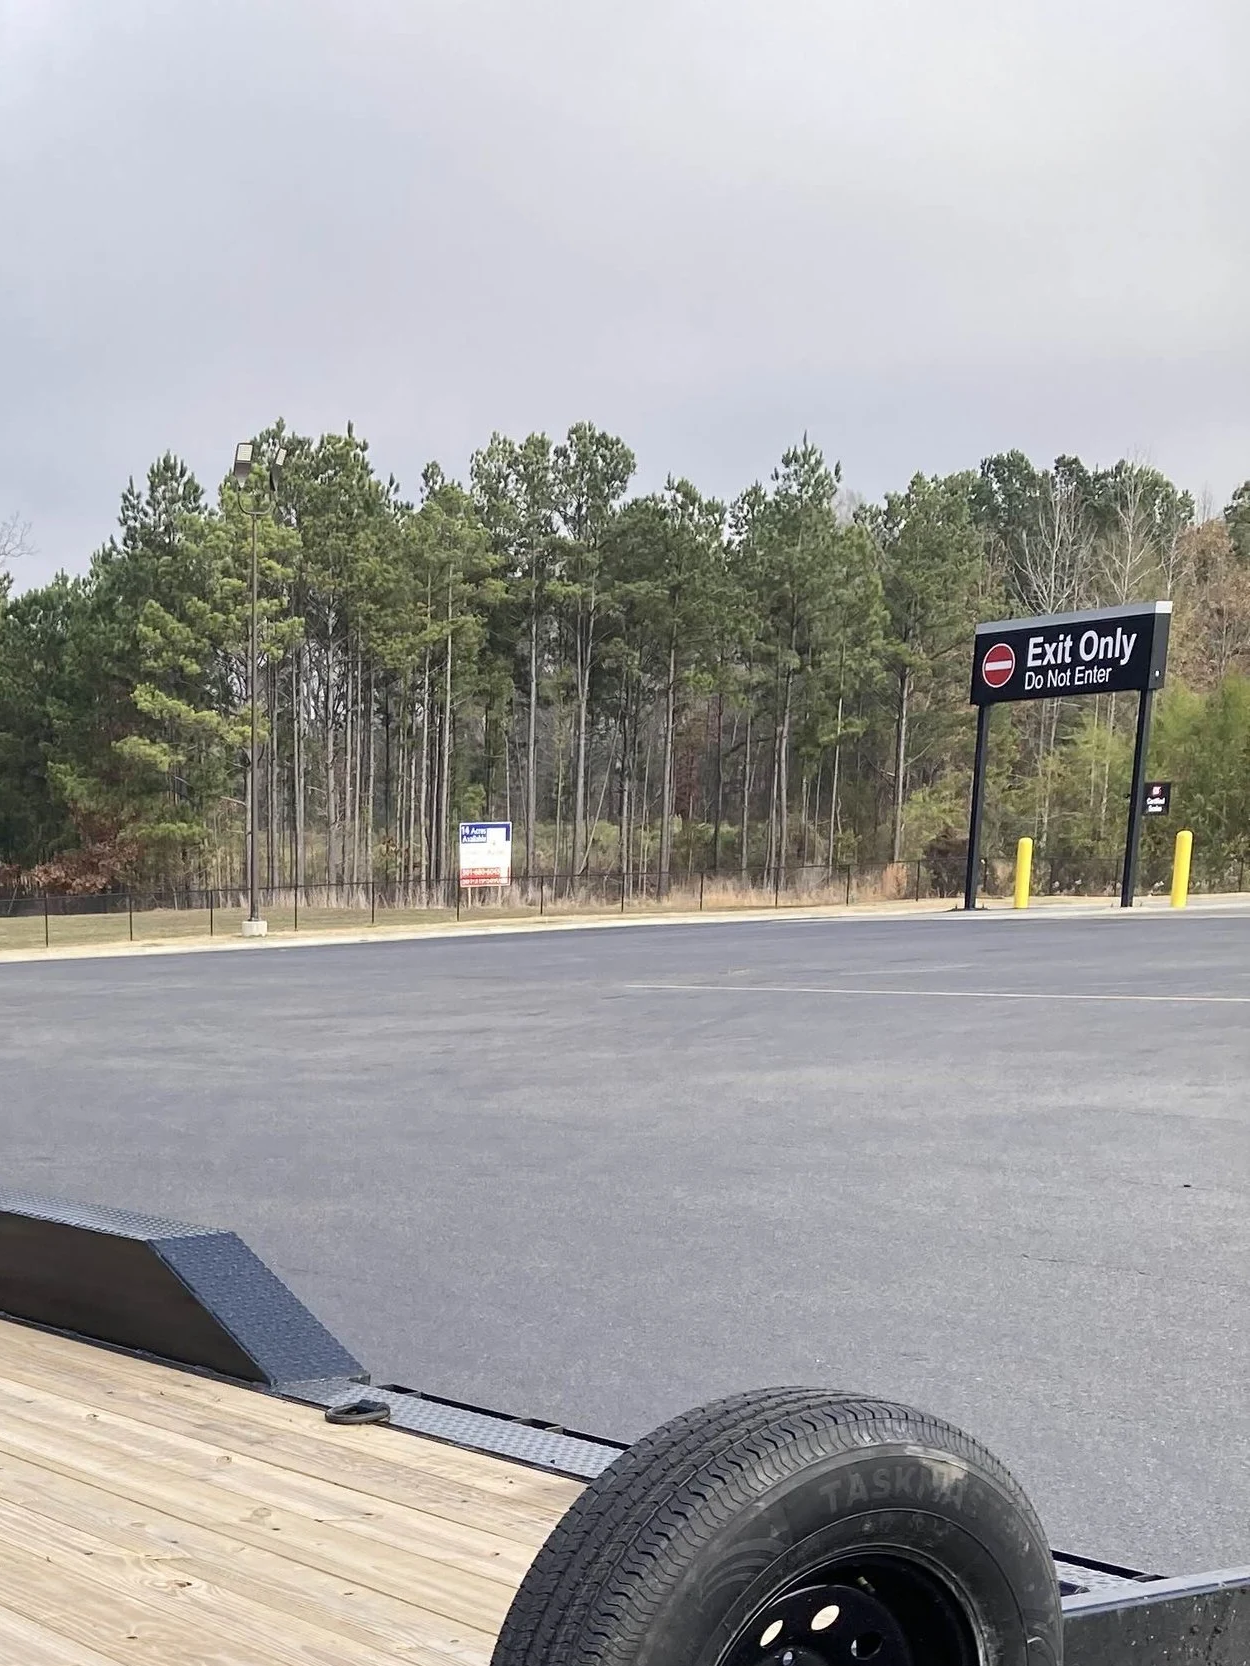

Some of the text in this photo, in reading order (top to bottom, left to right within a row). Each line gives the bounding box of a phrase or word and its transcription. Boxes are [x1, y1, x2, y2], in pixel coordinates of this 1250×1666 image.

[1026, 627, 1137, 667] Exit Only
[1024, 665, 1112, 690] Do Not Enter
[461, 826, 487, 835] 14 Acres
